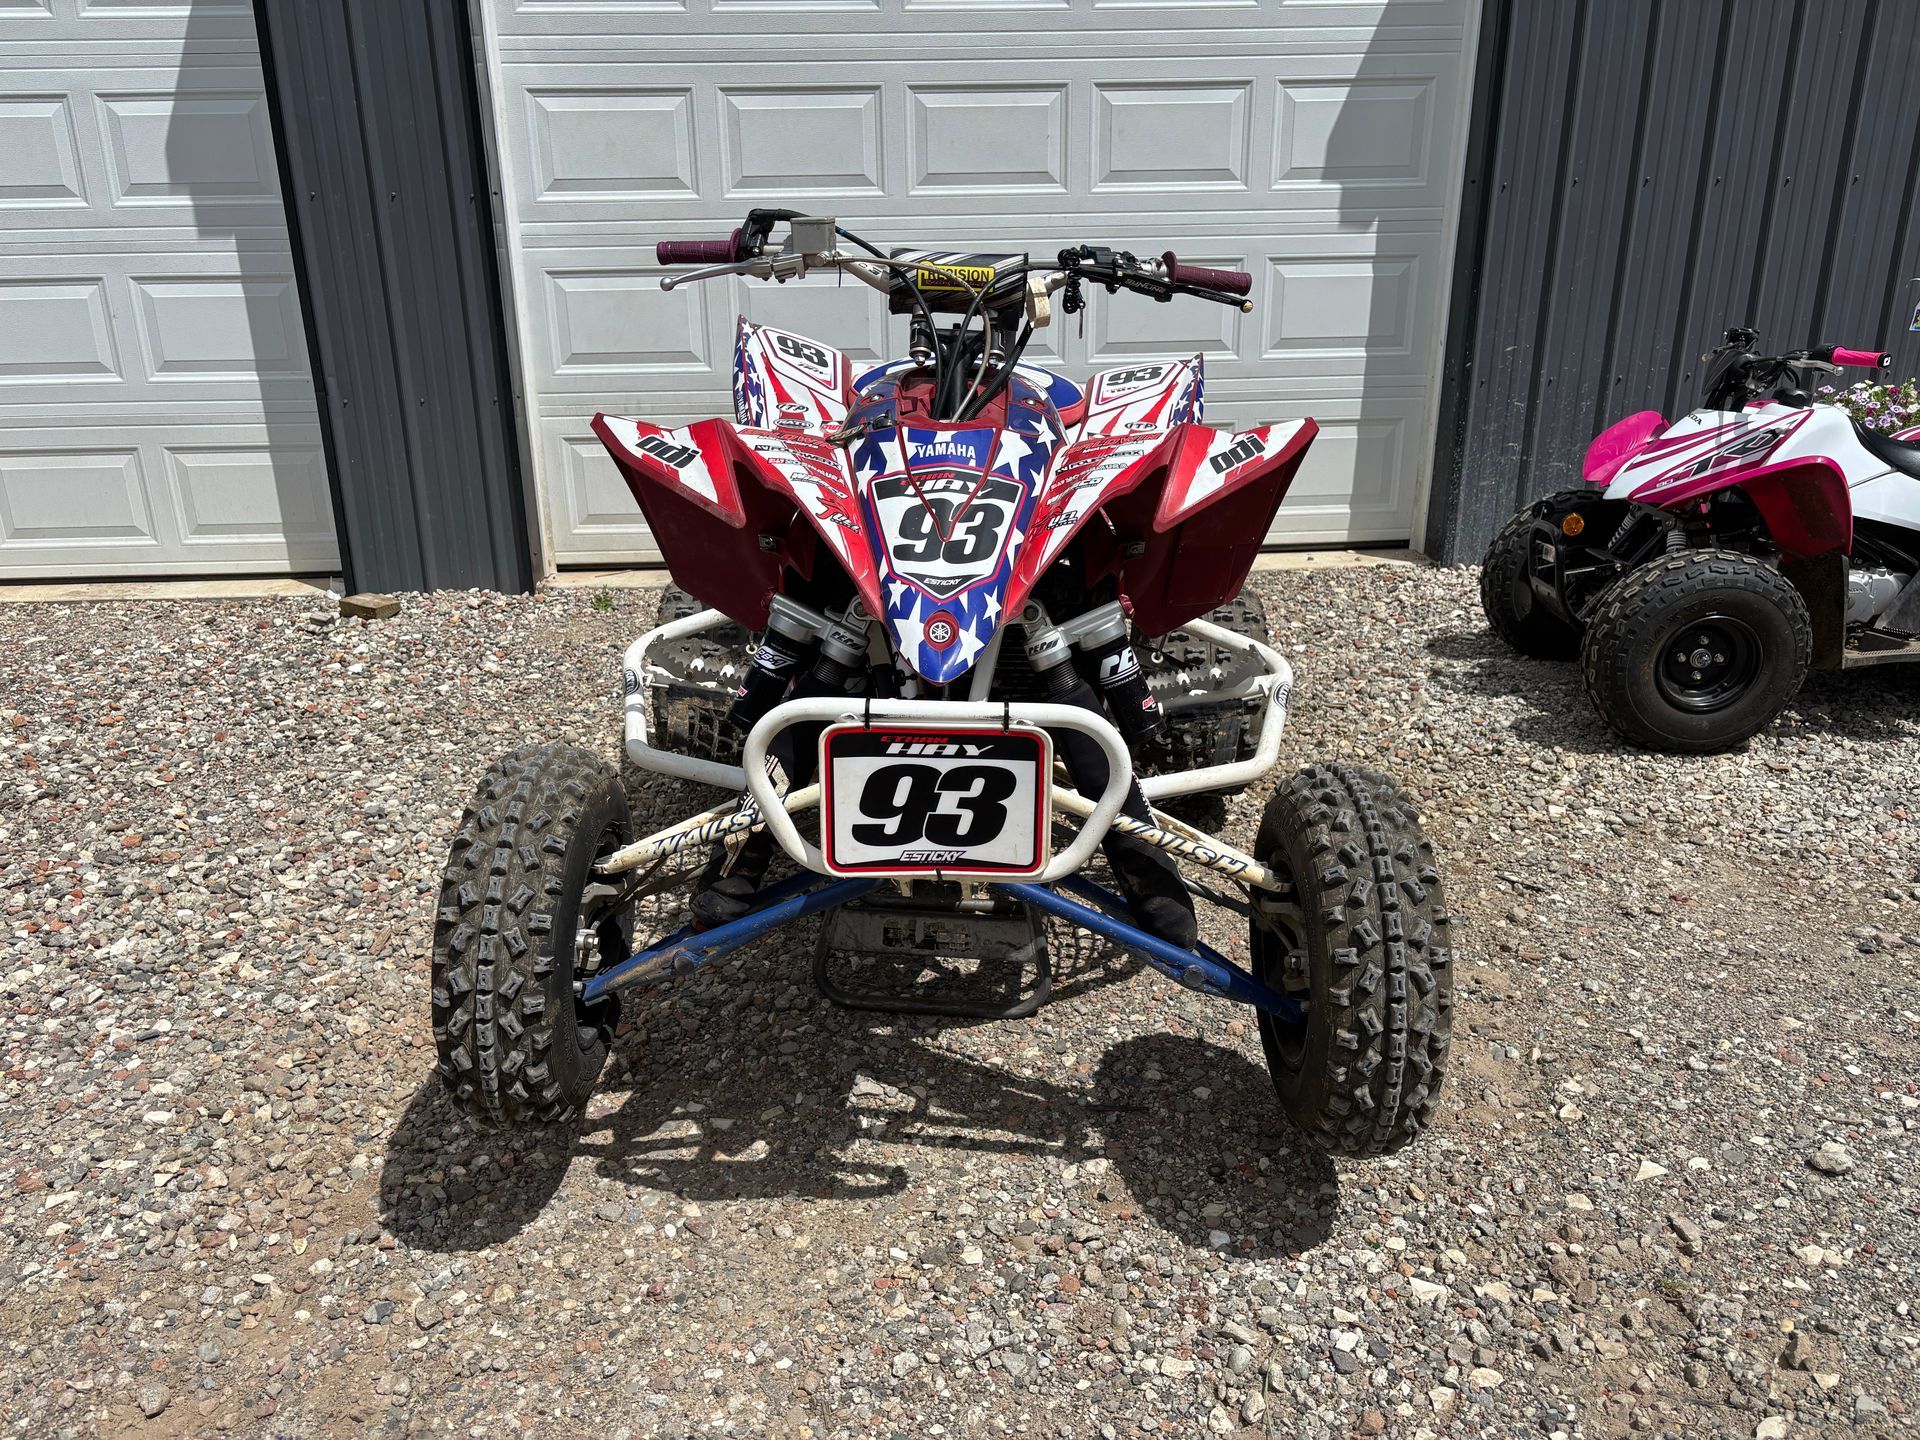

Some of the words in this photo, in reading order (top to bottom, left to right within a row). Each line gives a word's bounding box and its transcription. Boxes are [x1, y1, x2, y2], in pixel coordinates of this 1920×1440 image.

[777, 336, 829, 368] 93
[1107, 366, 1163, 386] 93
[917, 443, 976, 458] YAMAHA
[893, 498, 1005, 564] 93
[1100, 647, 1138, 677] PE
[886, 742, 995, 756] HAY
[852, 764, 1017, 847] 93
[1112, 813, 1249, 875] WALSH
